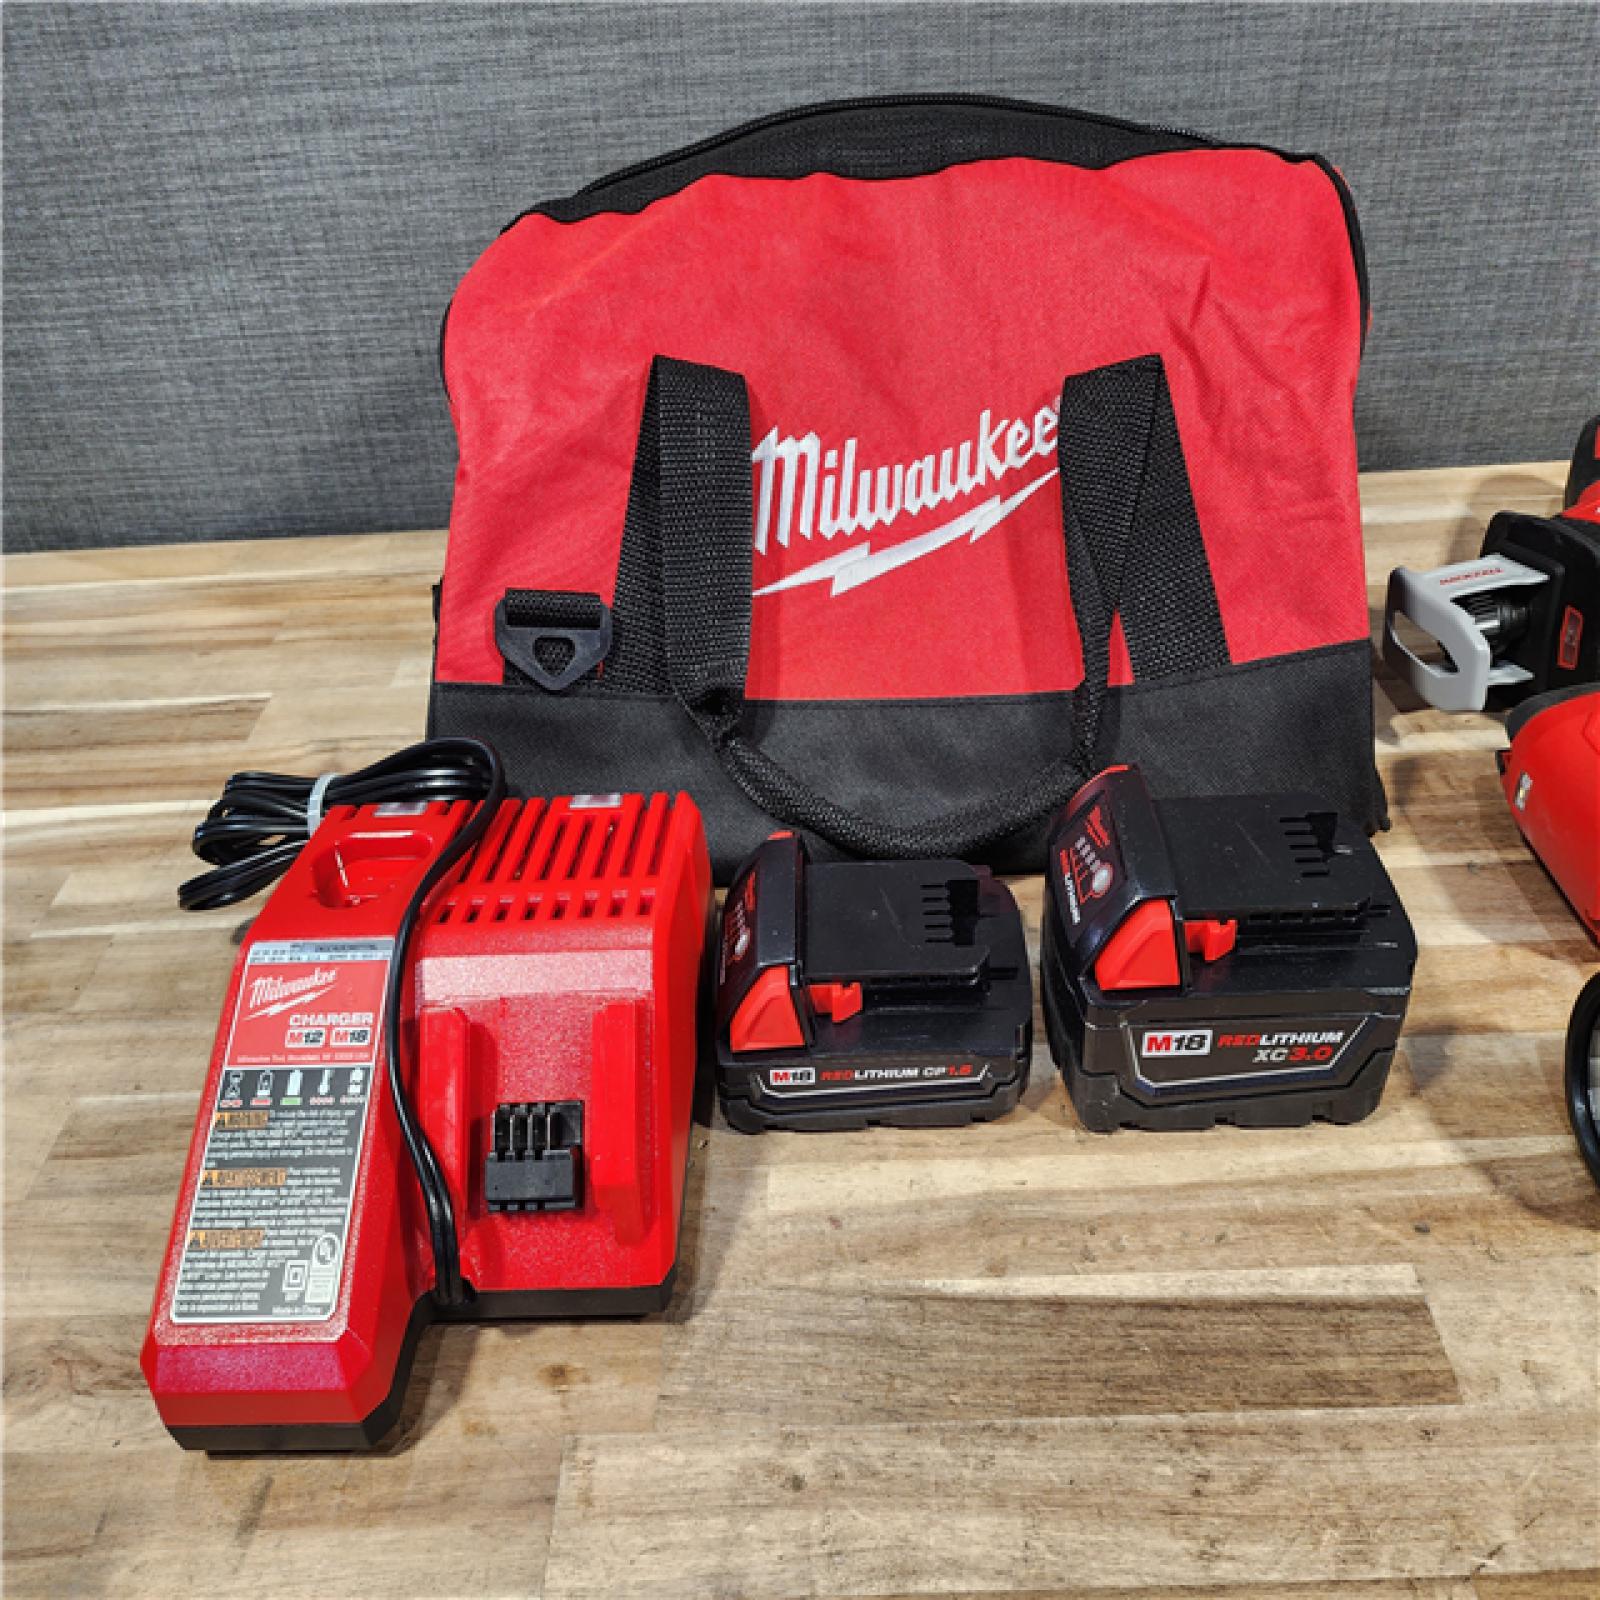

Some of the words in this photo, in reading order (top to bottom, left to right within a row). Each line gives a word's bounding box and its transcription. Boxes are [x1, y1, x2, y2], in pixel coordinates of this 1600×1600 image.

[752, 405, 1058, 555] Milwaukee
[289, 1012, 373, 1026] CHARGER
[289, 1029, 324, 1045] M12
[334, 1029, 369, 1044] M18
[1147, 1034, 1208, 1054] M18
[1217, 1030, 1345, 1048] REDLITHIUM
[772, 1069, 812, 1083] M18
